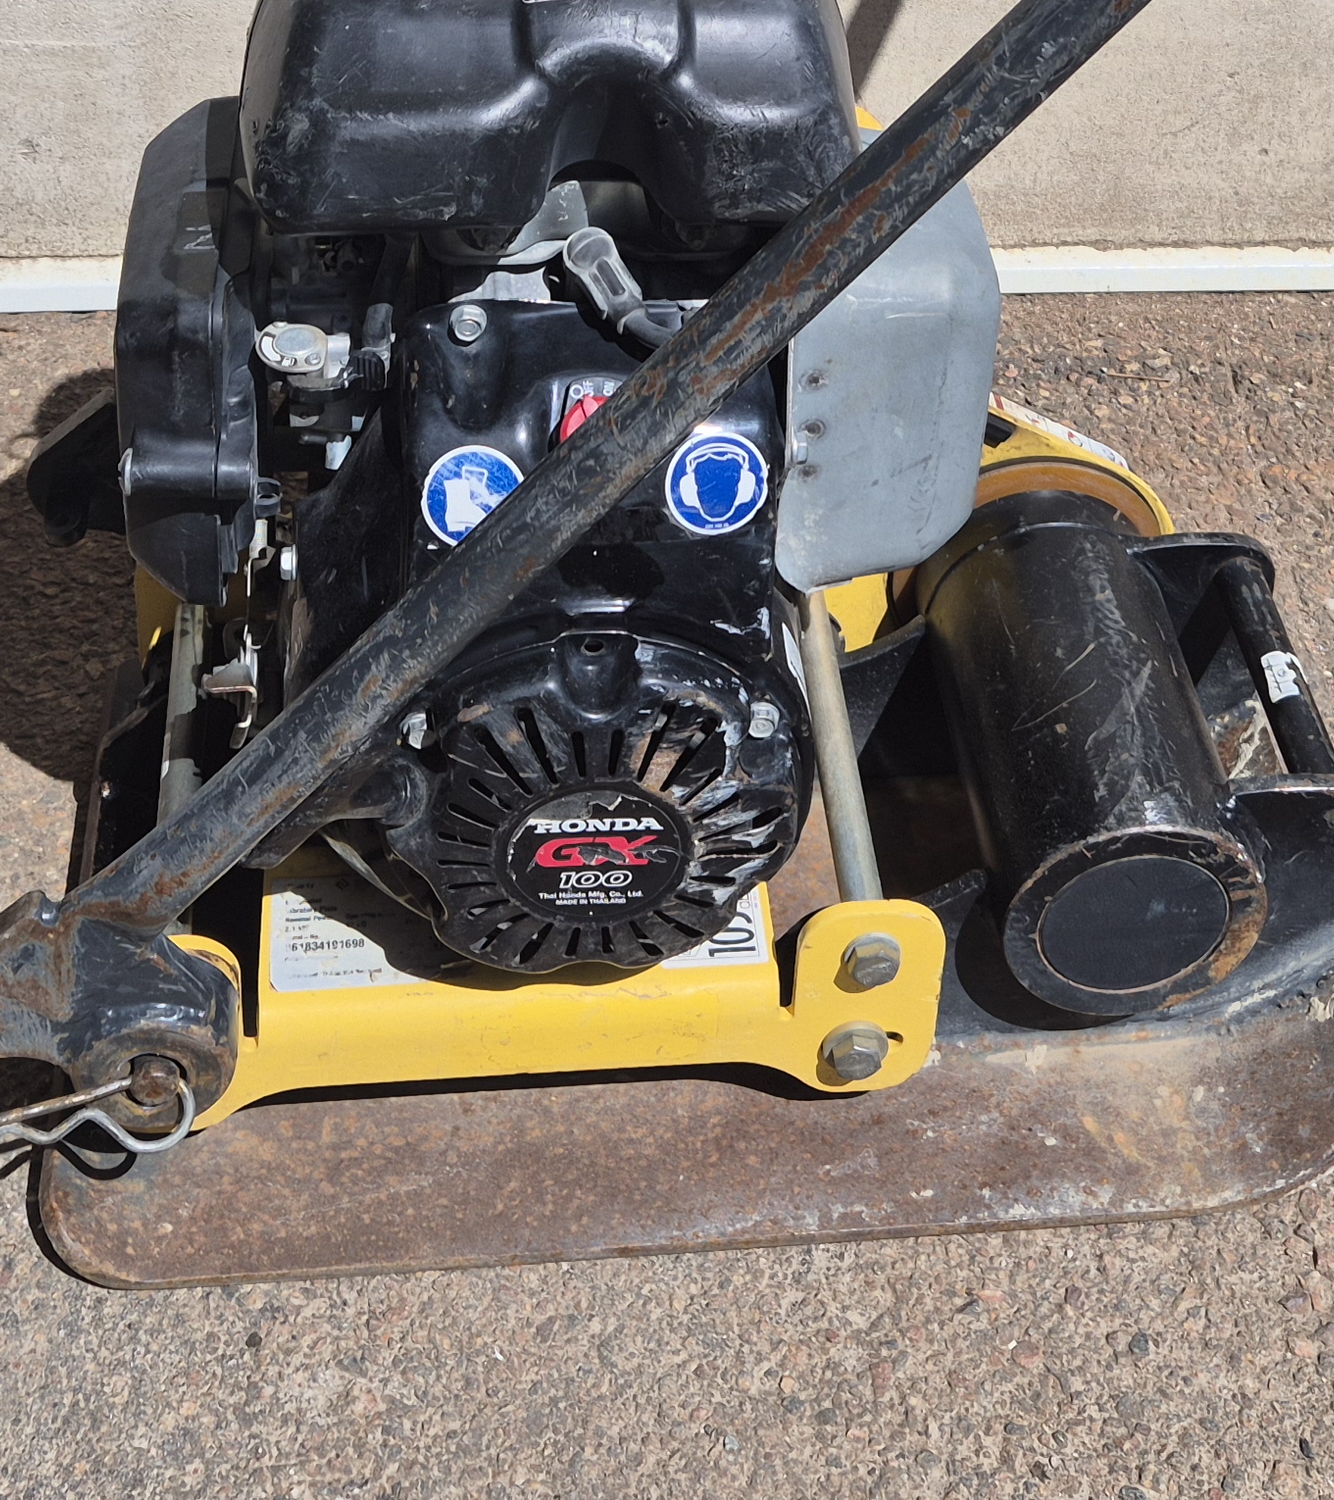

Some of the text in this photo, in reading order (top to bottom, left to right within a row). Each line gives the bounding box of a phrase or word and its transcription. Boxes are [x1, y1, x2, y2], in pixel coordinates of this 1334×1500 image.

[603, 381, 615, 397] ON
[531, 817, 665, 835] HONDA
[535, 835, 659, 868] GX
[559, 870, 633, 890] 100
[538, 892, 557, 900] Thai
[588, 890, 607, 898] Mfg.
[627, 889, 644, 898] Ltd.
[286, 938, 365, 952] 61834191698
